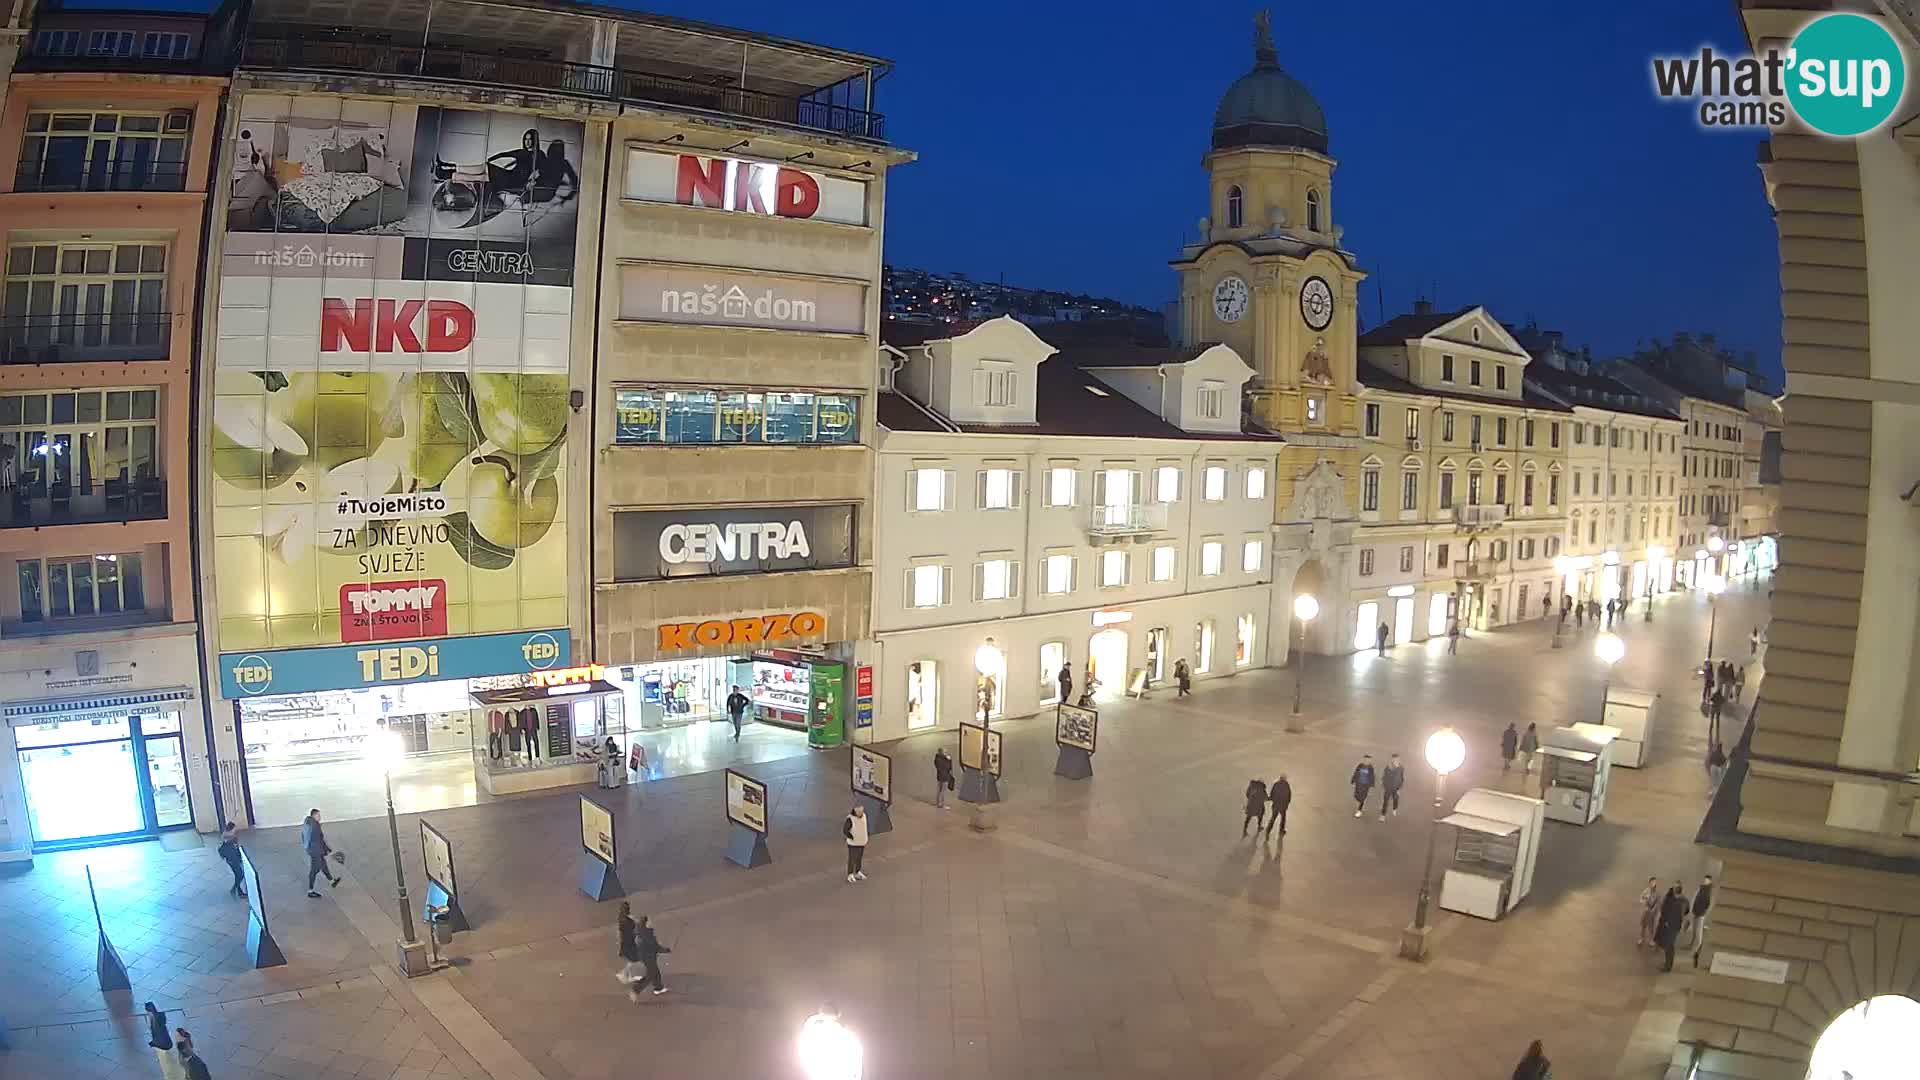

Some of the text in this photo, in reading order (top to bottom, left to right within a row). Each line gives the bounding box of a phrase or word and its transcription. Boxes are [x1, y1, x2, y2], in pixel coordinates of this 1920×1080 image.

[676, 154, 820, 219] NKD
[254, 246, 365, 269] naš dom
[448, 249, 534, 275] CENTRA
[661, 284, 816, 322] naš dom
[320, 297, 478, 353] NKD
[337, 496, 446, 516] #TvojeMisto
[333, 523, 450, 549] ZA DNEVNO
[659, 520, 810, 564] CENTRA
[359, 547, 426, 575] SVJEŽE
[348, 586, 438, 614] TOMMY
[658, 612, 826, 651] KORZO
[357, 645, 440, 682] TEDi
[521, 642, 560, 660] TEDi
[233, 667, 273, 684] TEDi
